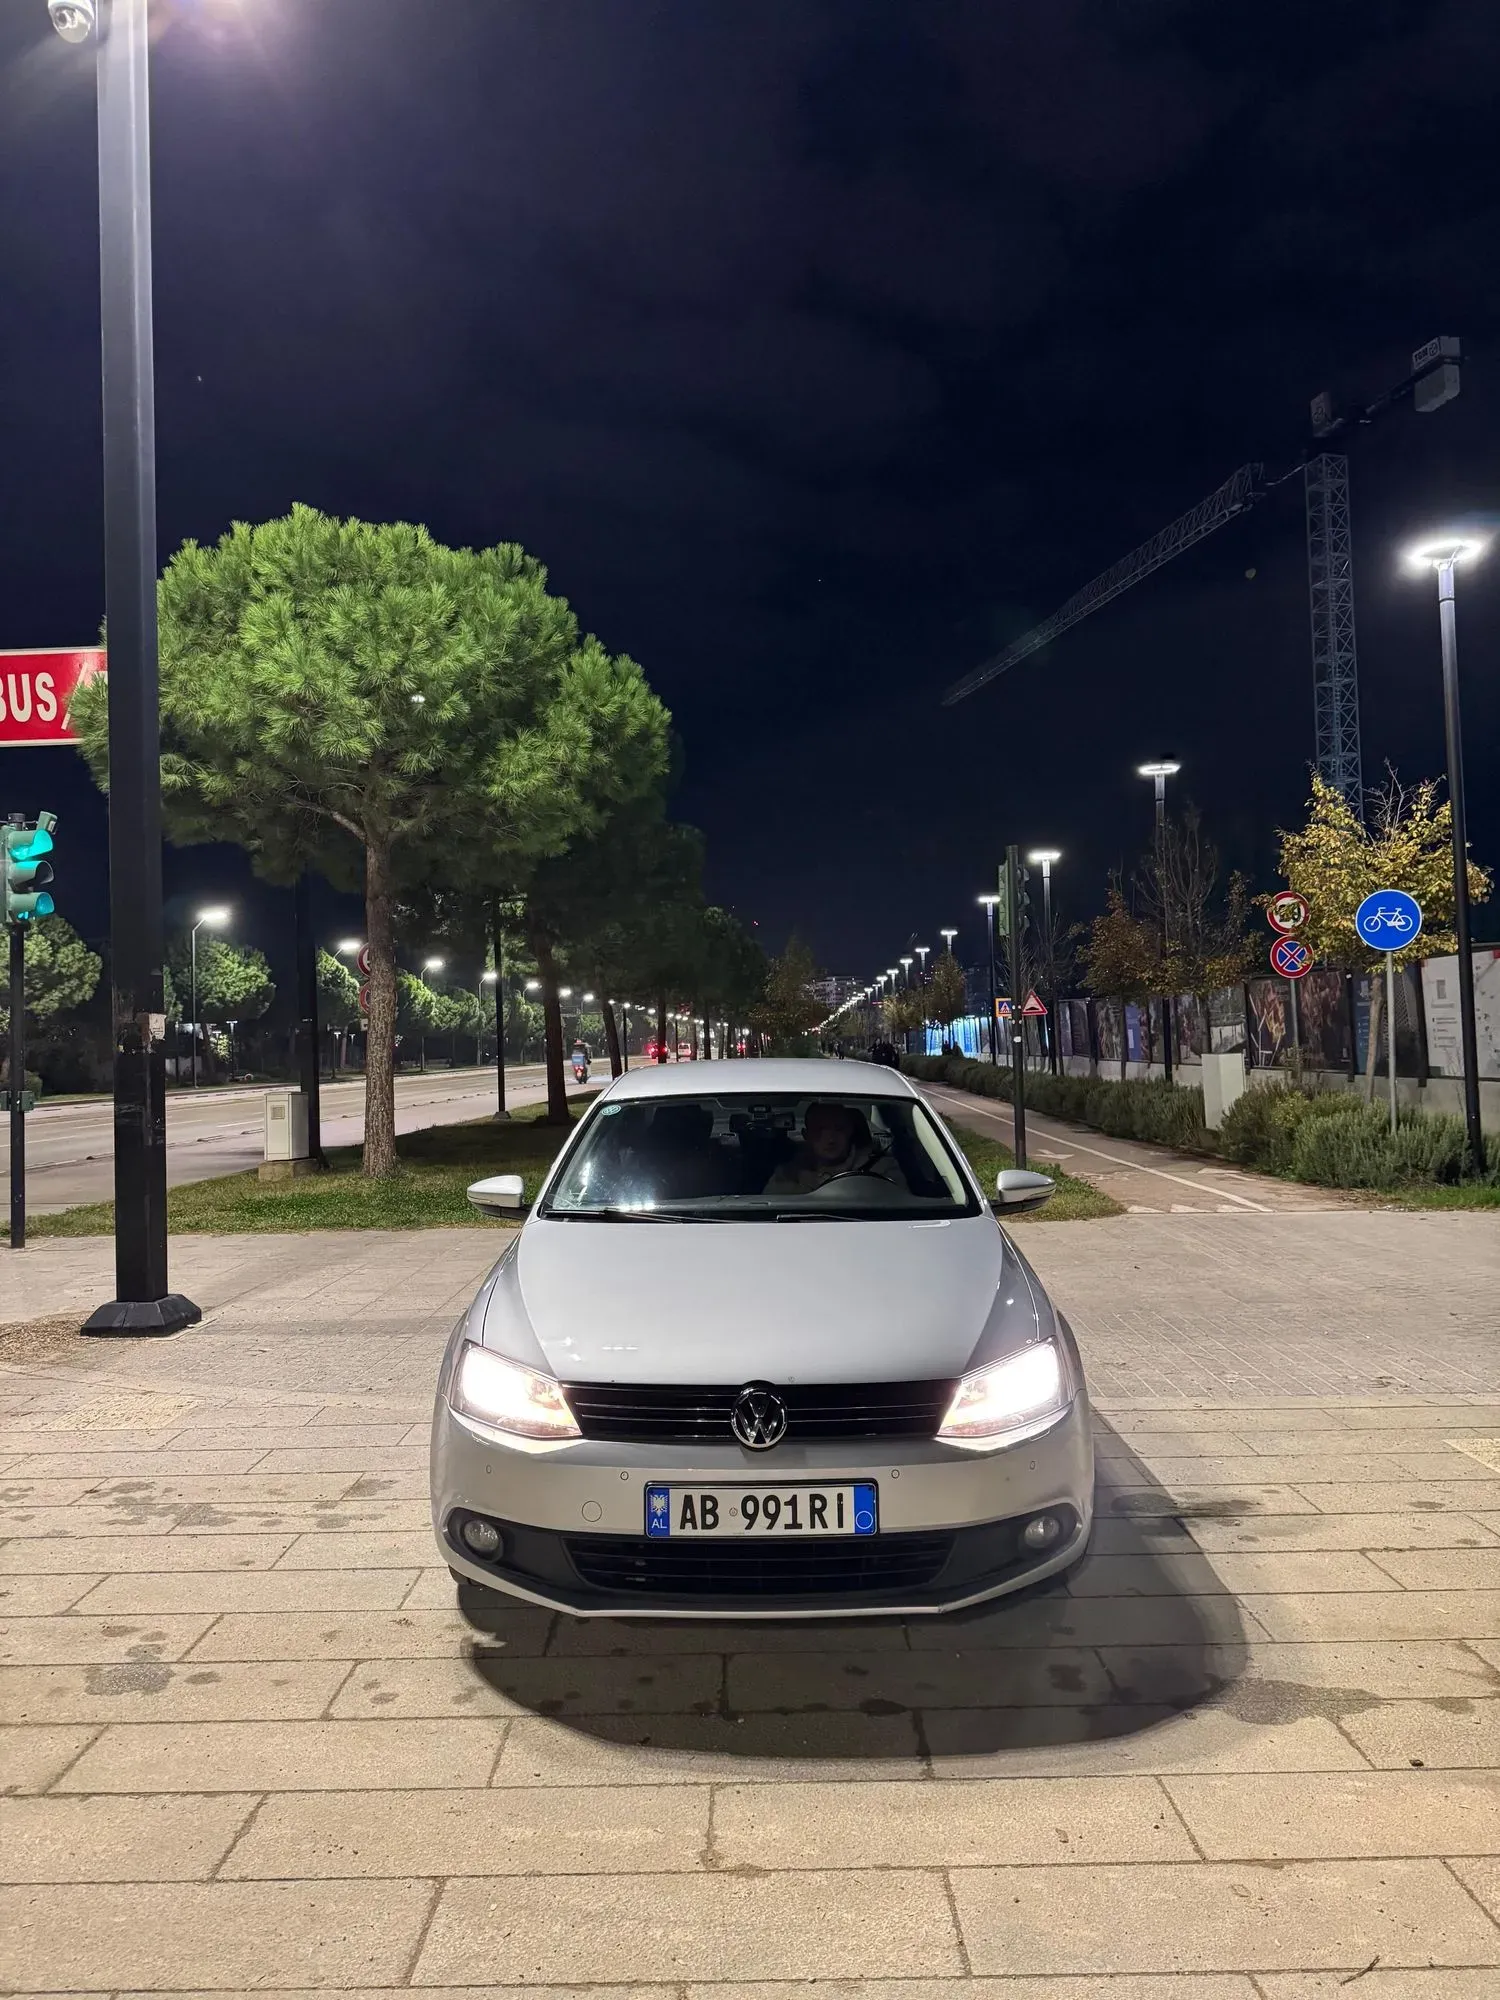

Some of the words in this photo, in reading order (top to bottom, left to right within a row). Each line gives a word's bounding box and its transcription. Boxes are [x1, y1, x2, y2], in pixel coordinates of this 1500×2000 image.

[0, 672, 57, 723] US
[651, 1518, 667, 1529] AL
[680, 1494, 719, 1530] AB
